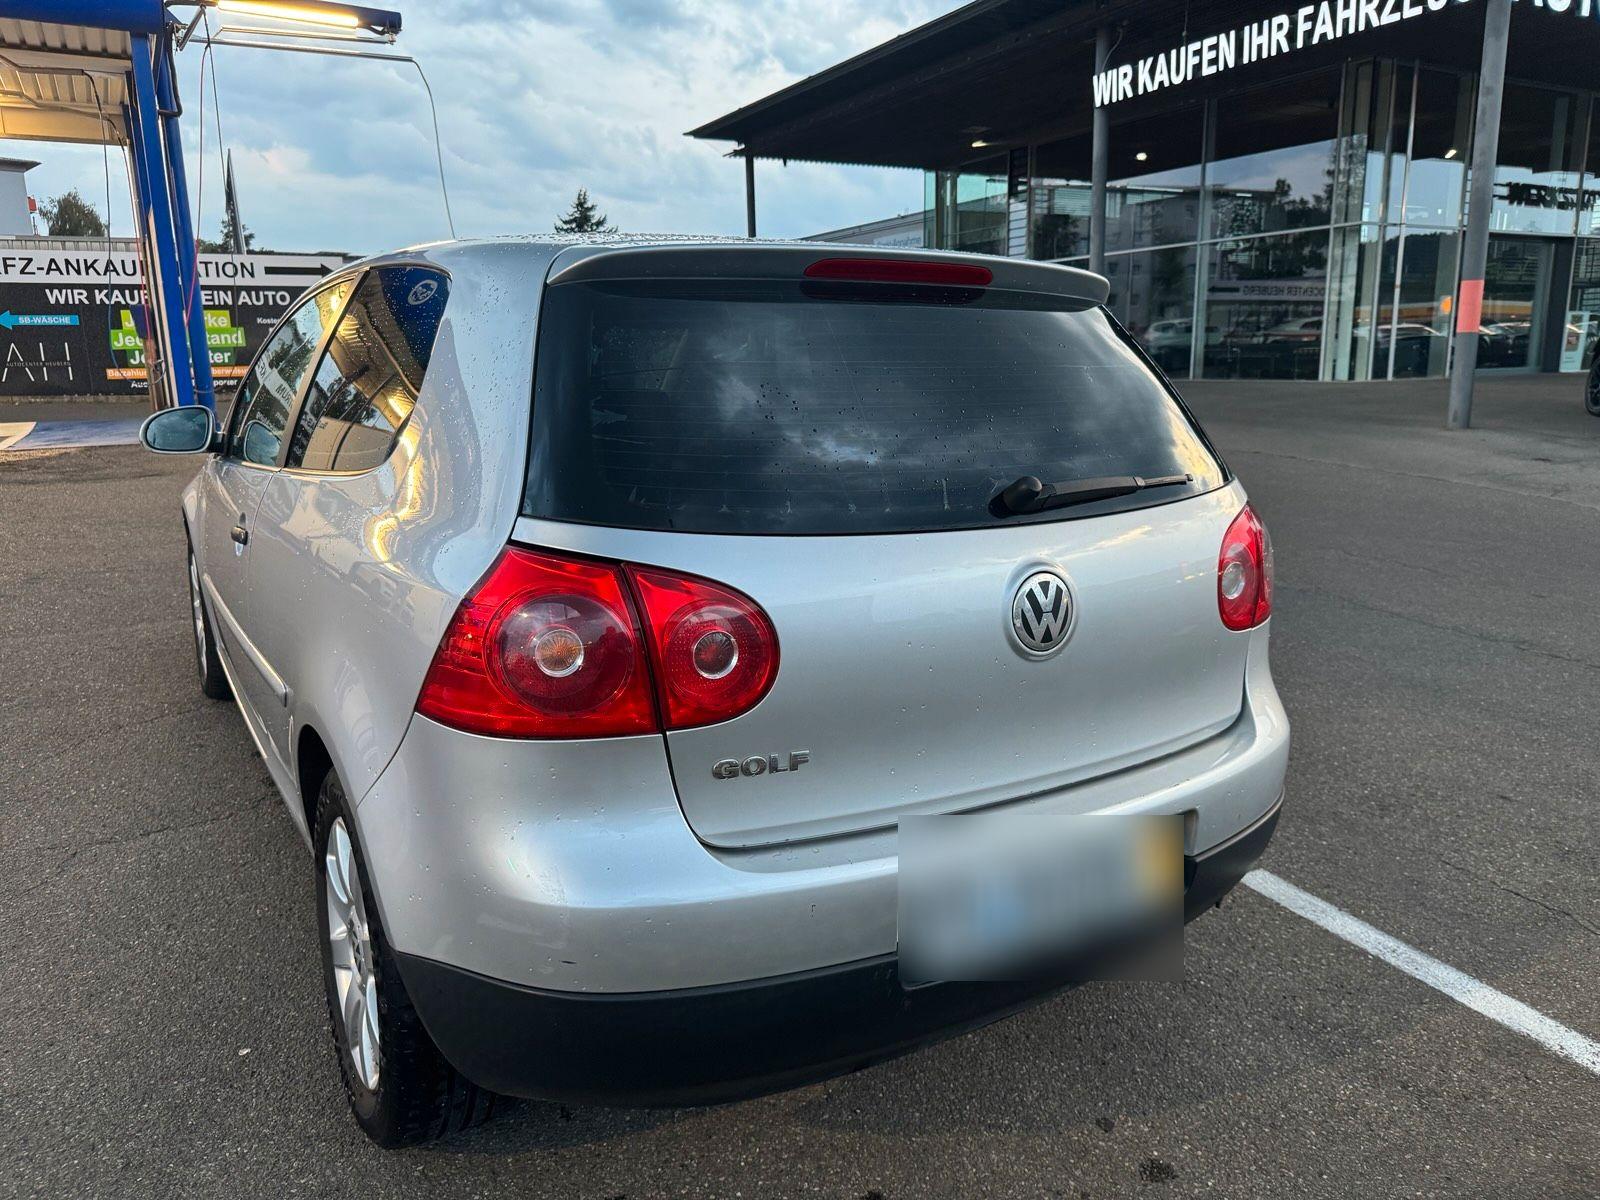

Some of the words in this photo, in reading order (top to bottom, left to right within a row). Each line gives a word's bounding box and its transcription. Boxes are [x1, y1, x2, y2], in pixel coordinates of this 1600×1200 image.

[1093, 64, 1133, 108] WIR
[1138, 30, 1235, 95] KAUFEN
[1242, 14, 1290, 64] IHR
[0, 257, 145, 277] FZ-ANKAU
[198, 261, 255, 278] TION
[45, 288, 89, 305] WIR
[202, 291, 232, 306] EIN
[237, 291, 290, 306] AUTO
[206, 329, 243, 345] tand
[208, 350, 231, 363] ter
[108, 369, 147, 377] Barzahlu
[712, 750, 810, 780] GOLF
